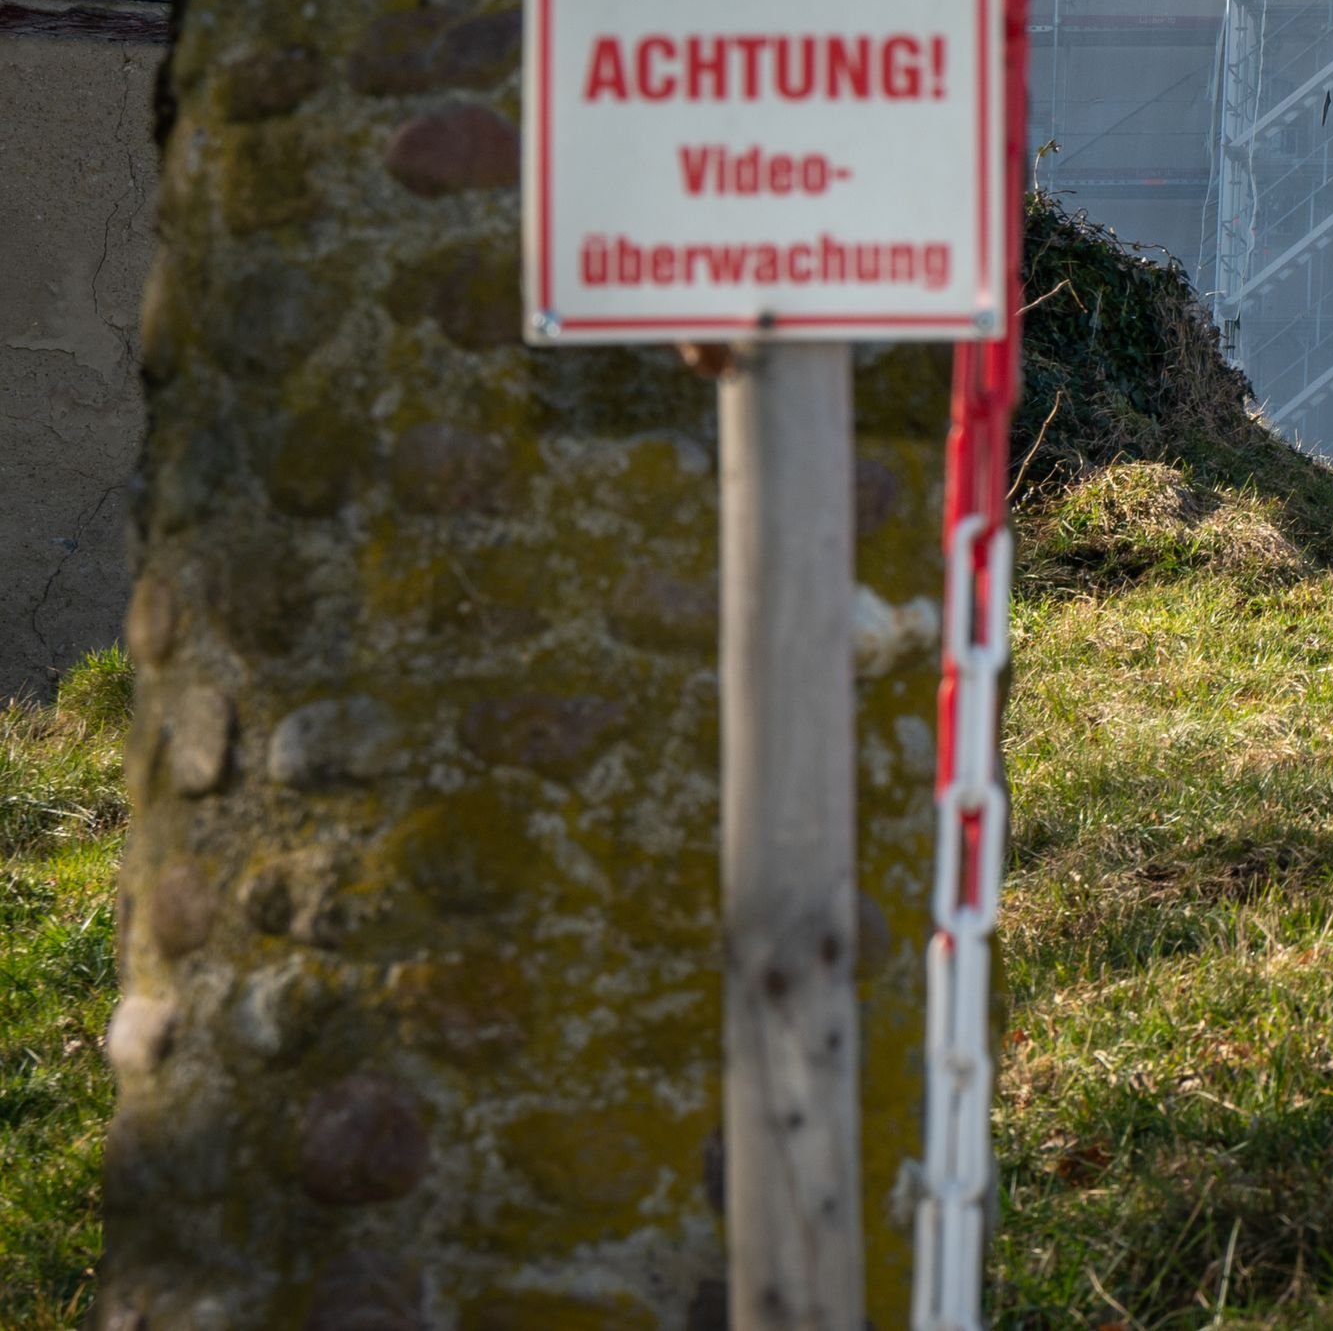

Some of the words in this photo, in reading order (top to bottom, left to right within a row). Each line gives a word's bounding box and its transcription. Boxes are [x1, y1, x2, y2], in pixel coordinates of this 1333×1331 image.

[584, 34, 947, 103] ACHTUNG!
[679, 145, 853, 197] Video-
[579, 233, 952, 290] überwachung
